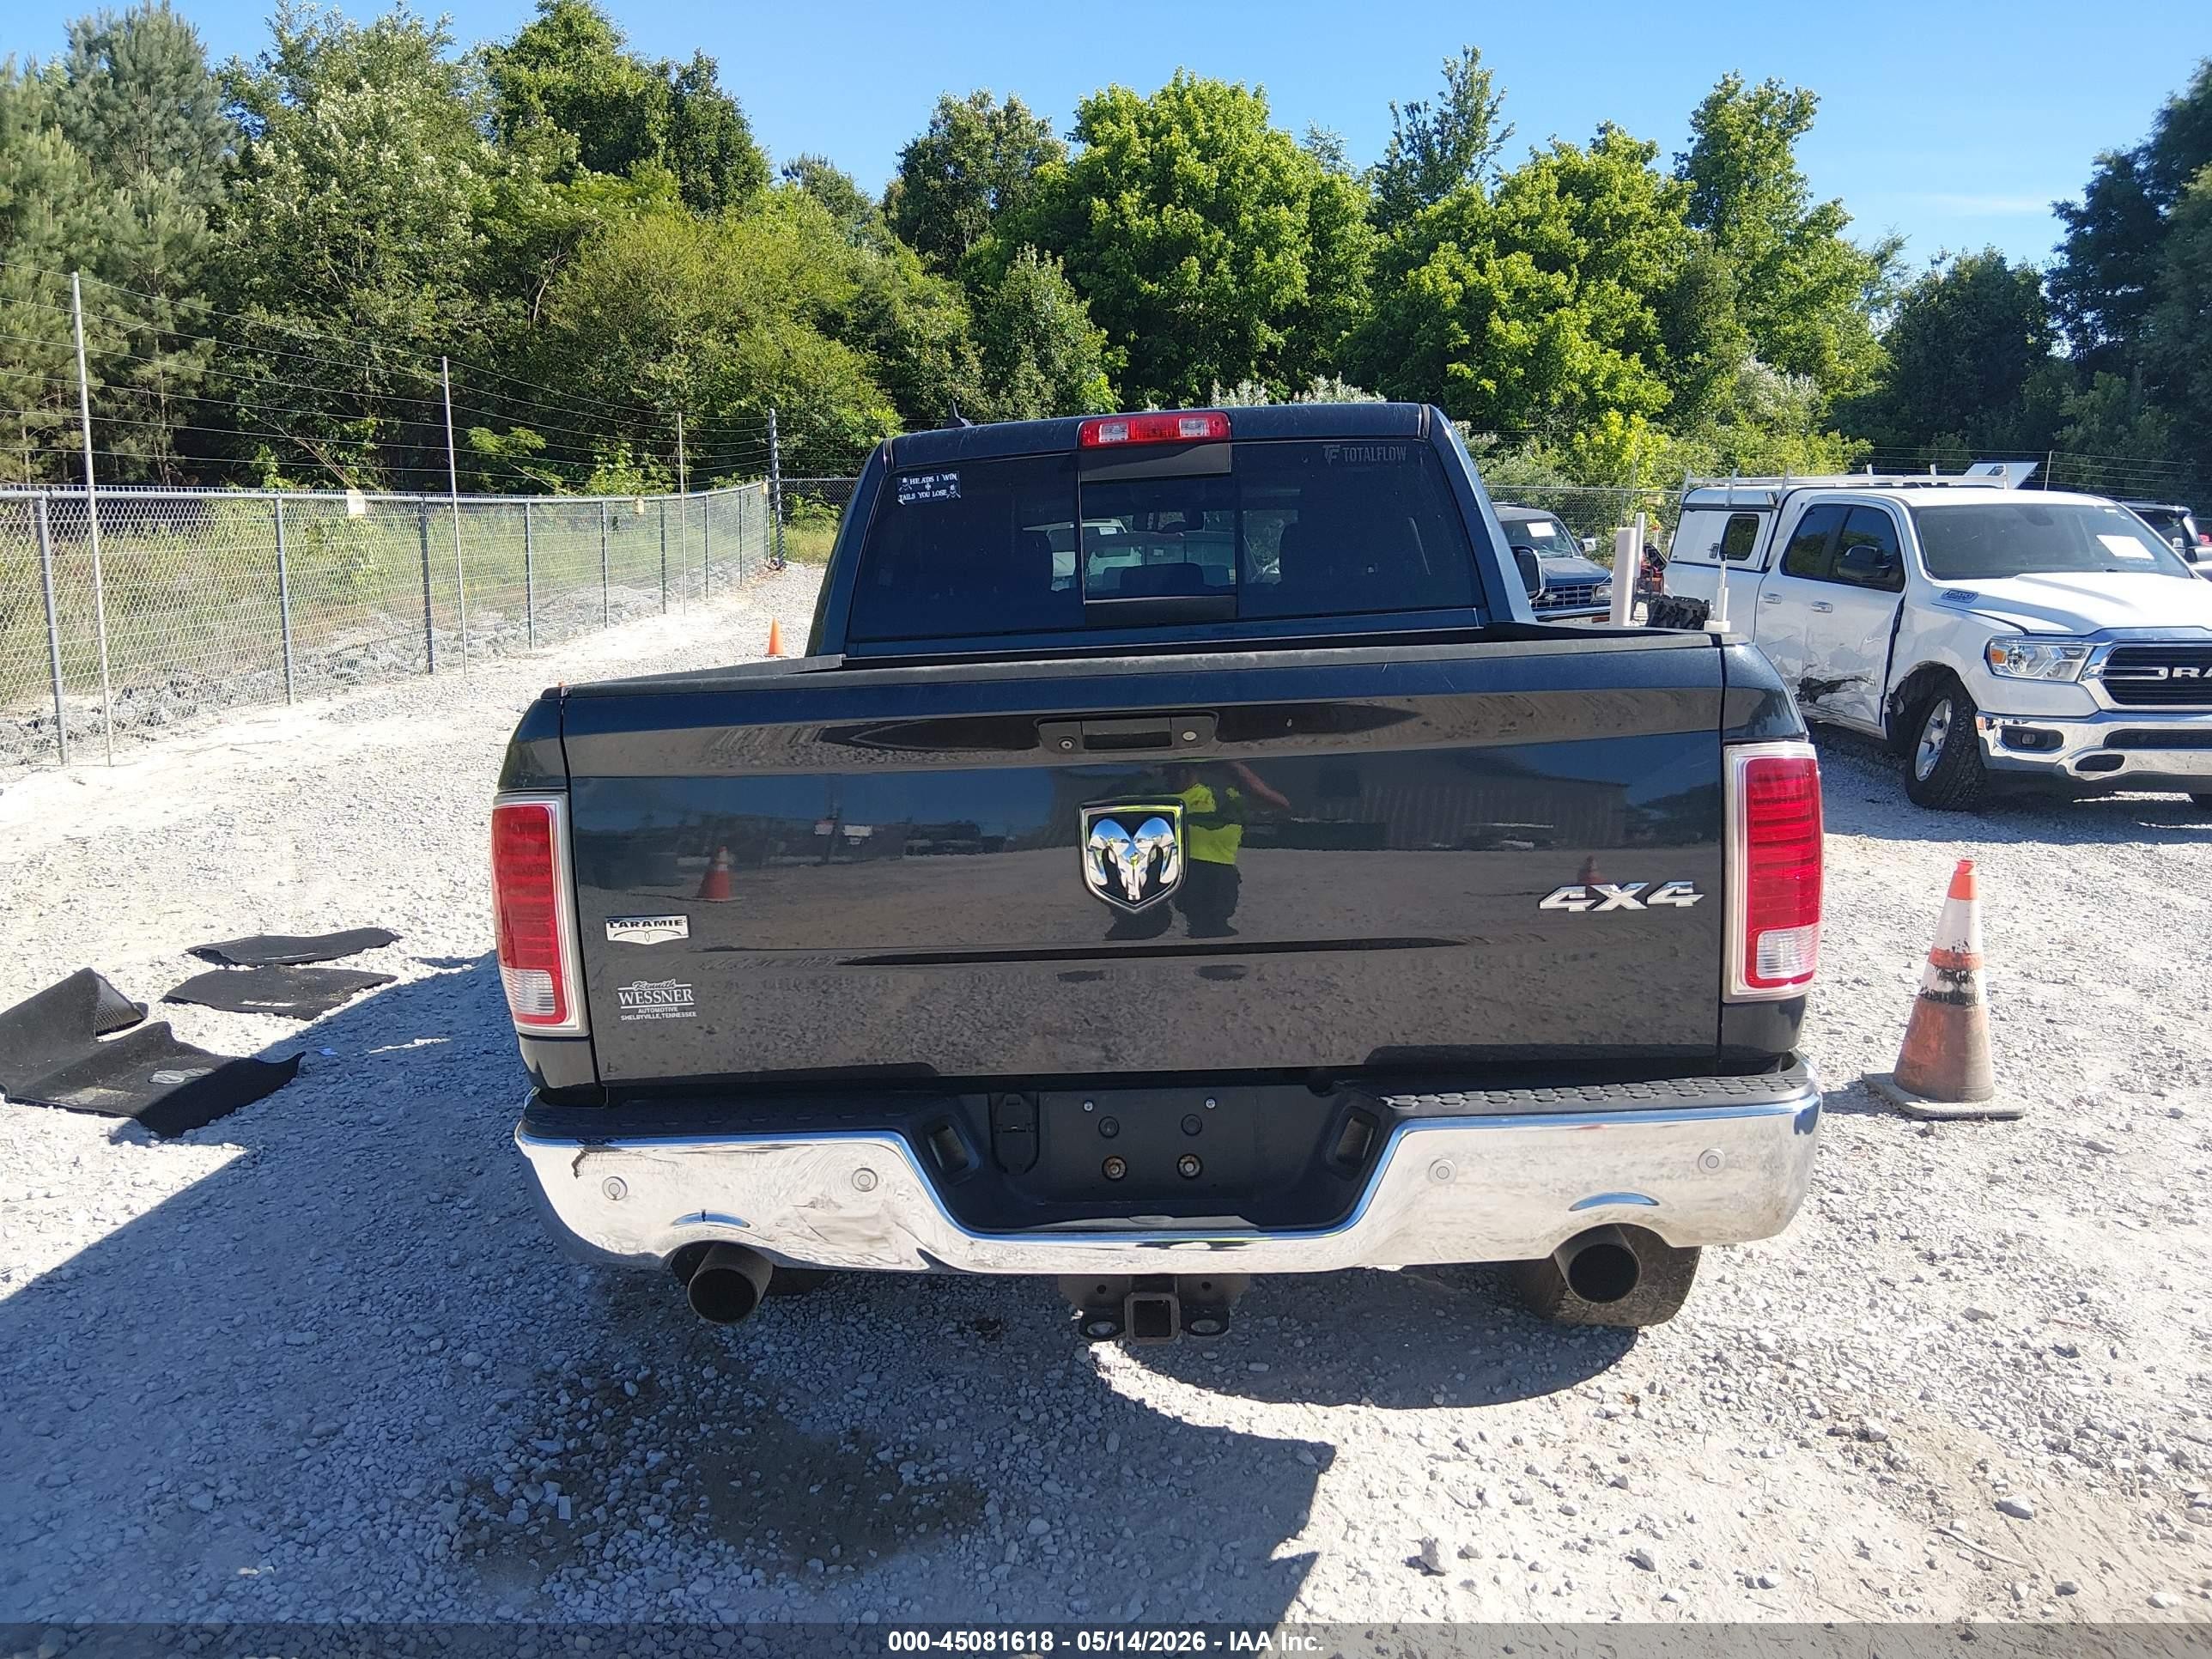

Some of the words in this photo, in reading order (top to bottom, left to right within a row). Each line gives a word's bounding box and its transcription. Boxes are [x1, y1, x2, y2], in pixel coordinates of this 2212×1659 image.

[1342, 446, 1407, 462] TOTALFLOW
[909, 476, 934, 485] HEADS
[941, 472, 958, 481] WIN
[932, 489, 948, 497] LOSE
[609, 919, 684, 929] LARAMIE
[618, 988, 695, 1006] WESSNER
